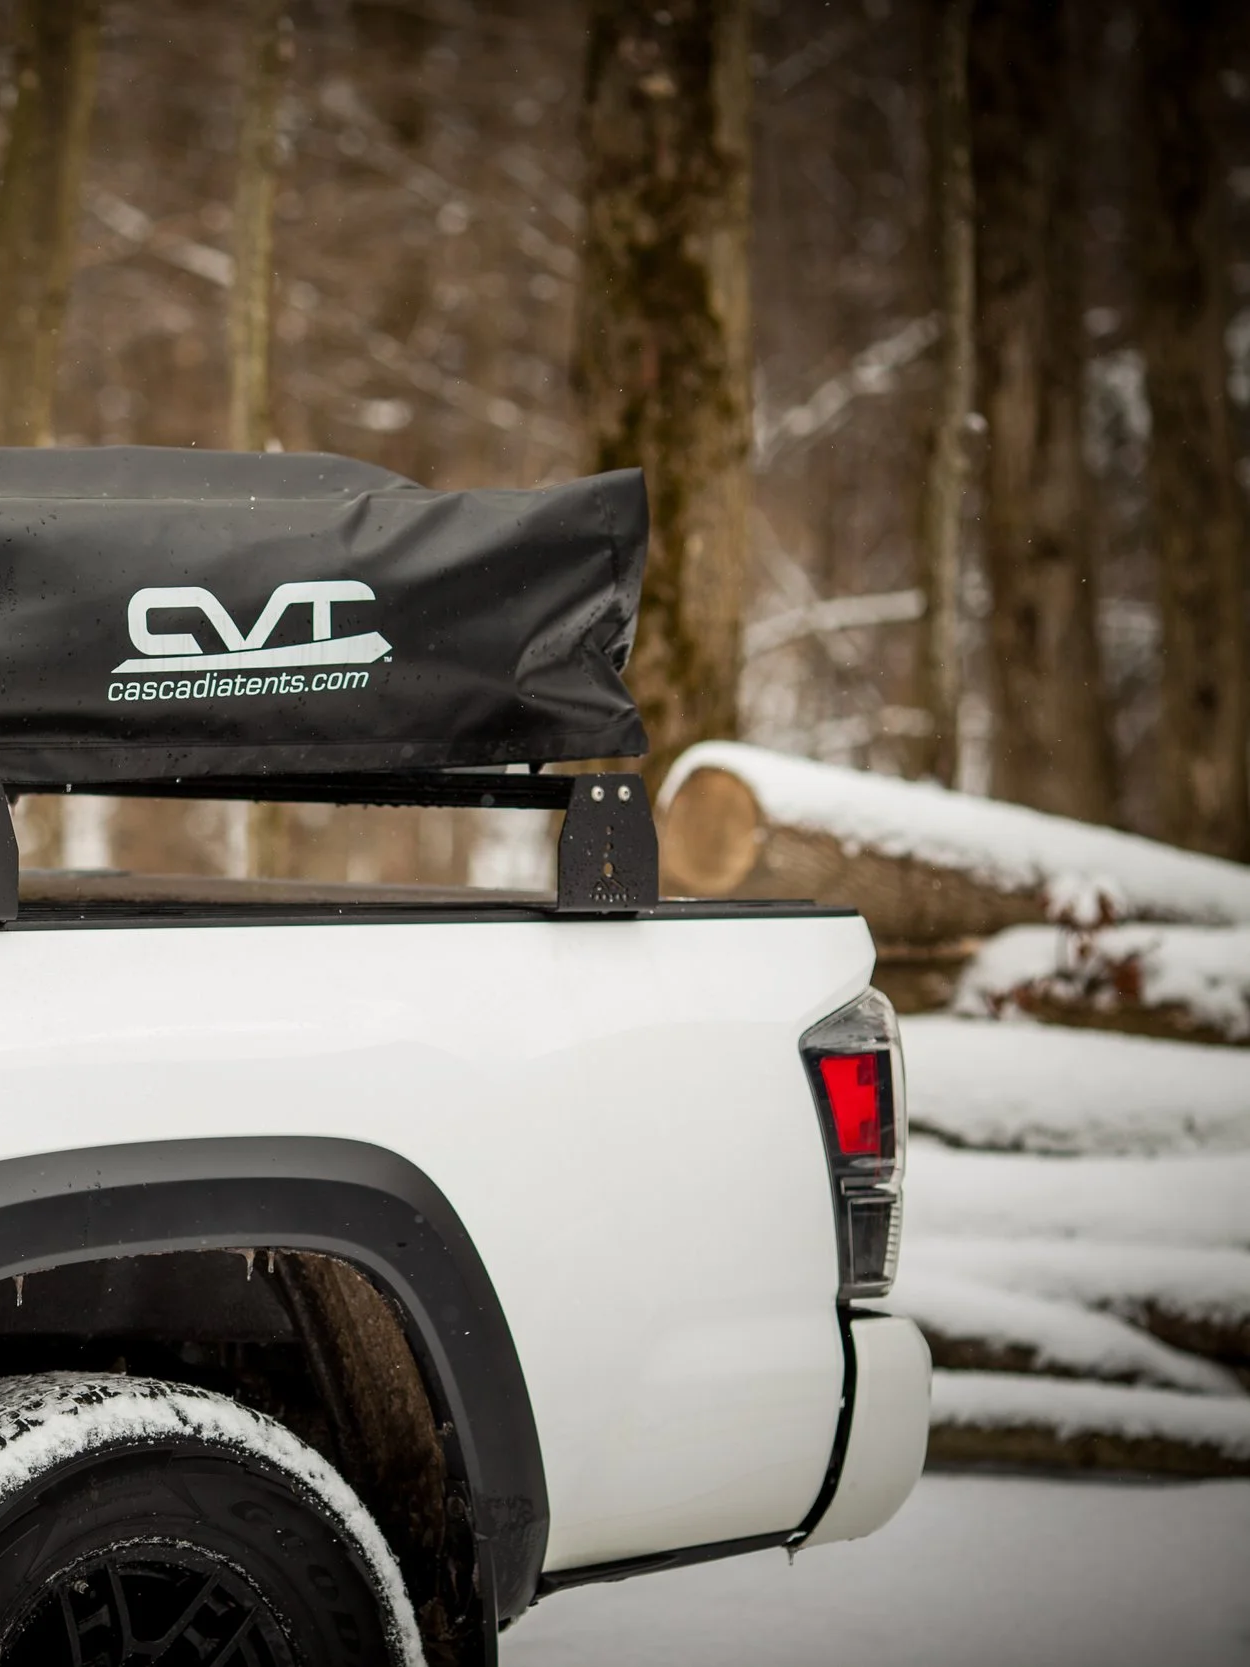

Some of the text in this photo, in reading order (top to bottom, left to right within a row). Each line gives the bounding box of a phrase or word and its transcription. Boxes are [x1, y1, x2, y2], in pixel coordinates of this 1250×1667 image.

[127, 580, 376, 656] CVT
[107, 671, 370, 702] cascadiatents.com
[229, 1499, 363, 1667] GOOD
